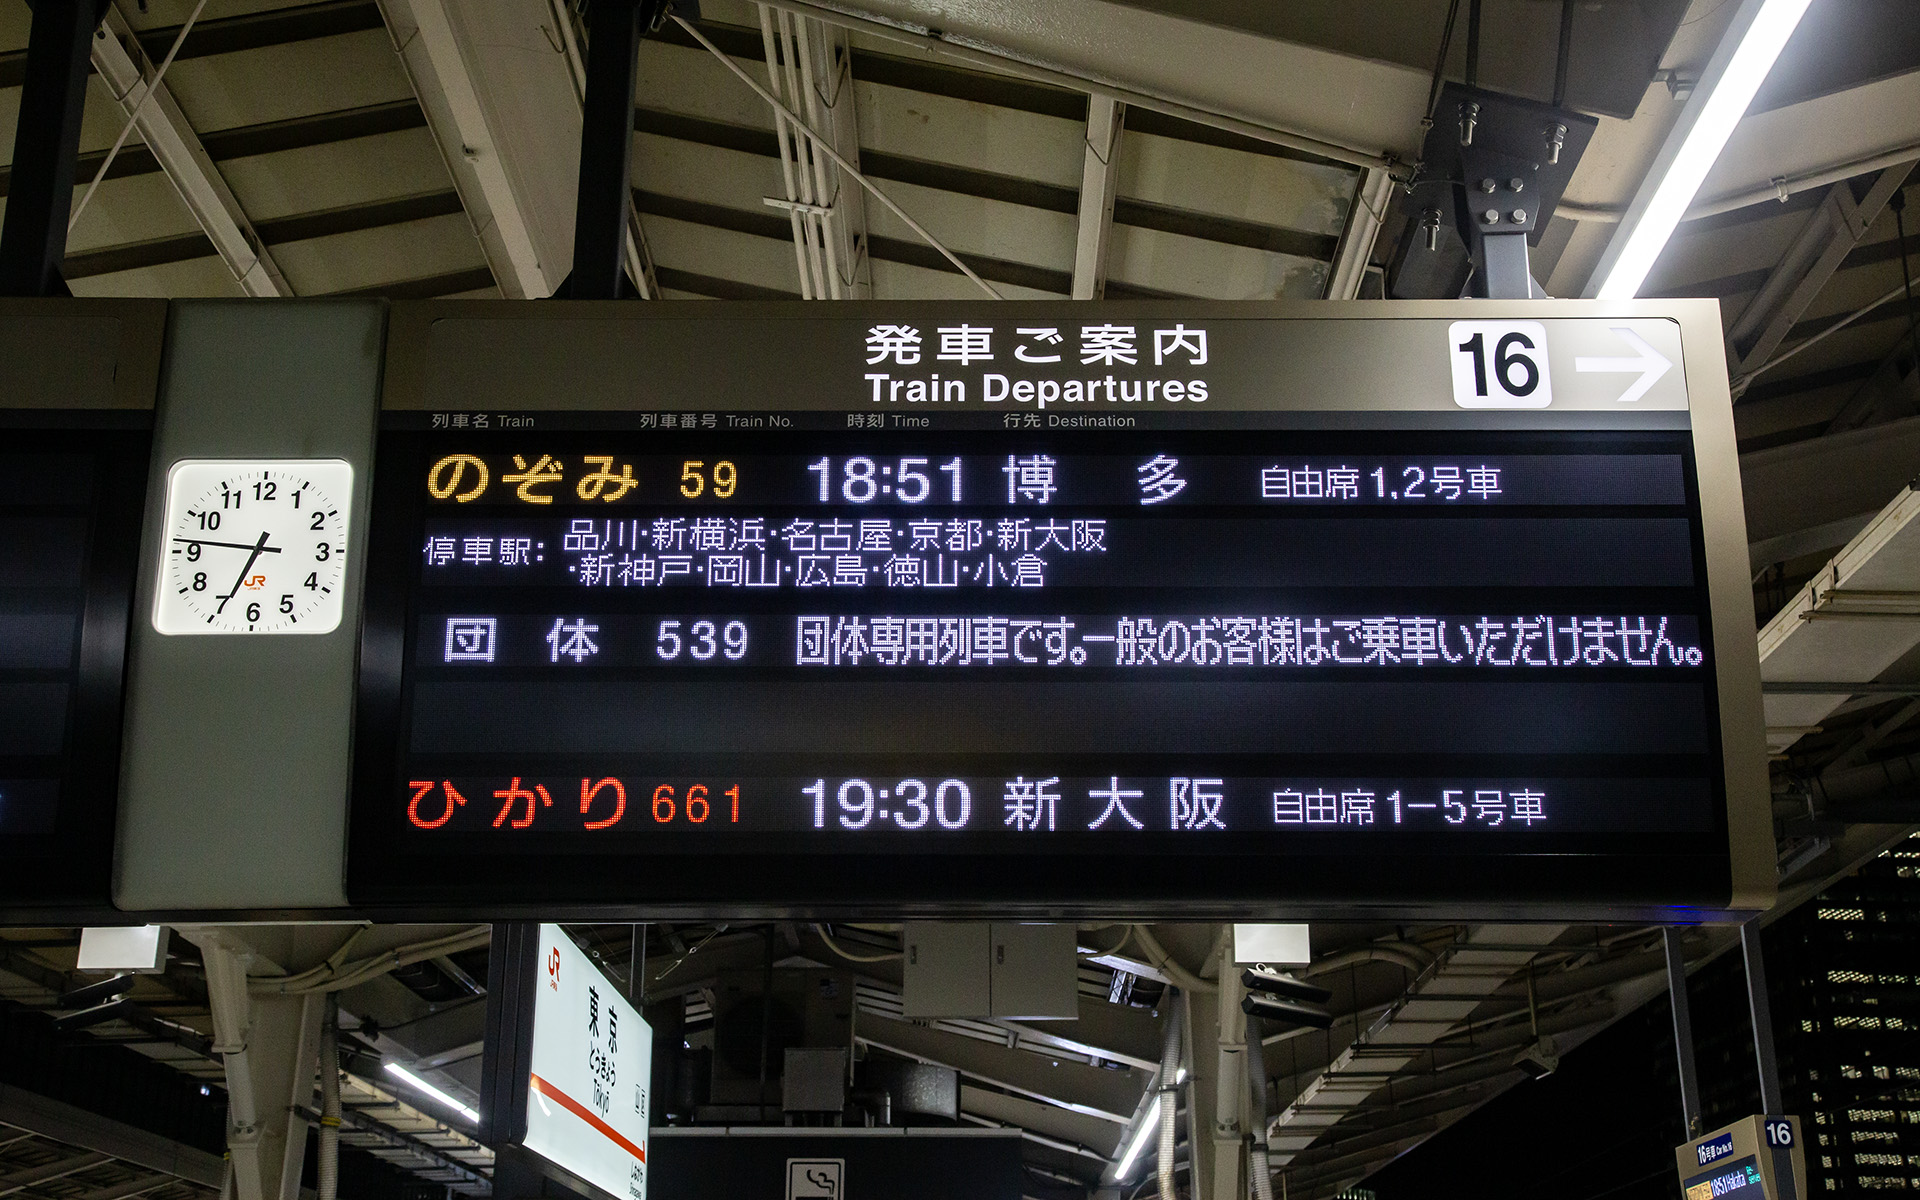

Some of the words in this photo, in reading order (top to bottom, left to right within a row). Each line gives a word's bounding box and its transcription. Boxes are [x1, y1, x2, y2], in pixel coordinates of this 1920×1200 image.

[866, 323, 1208, 366] 発車ご案内
[1459, 333, 1538, 397] 16
[865, 374, 965, 402] Train
[983, 373, 1209, 409] Departures
[432, 413, 489, 429] 列車名
[498, 415, 534, 427] Train
[640, 413, 717, 429] 列車番号
[726, 415, 763, 427] Train
[769, 415, 794, 427] No.
[847, 413, 884, 428] 時刻
[892, 414, 930, 427] Time
[1003, 413, 1041, 428] 行先
[1049, 414, 1136, 427] Destination
[427, 454, 639, 505] のぞみ
[680, 461, 737, 498] 59
[807, 456, 968, 504] 18:51
[221, 491, 242, 509] 11
[252, 482, 277, 500] 12
[291, 491, 301, 509] 1
[197, 511, 221, 530] 10
[310, 512, 325, 530] 2
[187, 543, 201, 561] 9
[316, 542, 330, 561] 3
[193, 572, 207, 591] 8
[244, 575, 266, 587] JR
[304, 572, 318, 591] 4
[216, 595, 231, 614] 7
[247, 603, 260, 622] 6
[279, 595, 294, 613] 5
[656, 620, 748, 661] 539
[407, 777, 627, 830] ひかり
[652, 784, 741, 823] 661
[801, 779, 971, 830] 19:30
[1003, 776, 1227, 832] 新大阪
[548, 946, 560, 982] JR
[588, 985, 618, 1054] 東京
[589, 1040, 616, 1087] とうきょう
[1767, 1123, 1792, 1145] 16
[1698, 1145, 1716, 1164] 16号車
